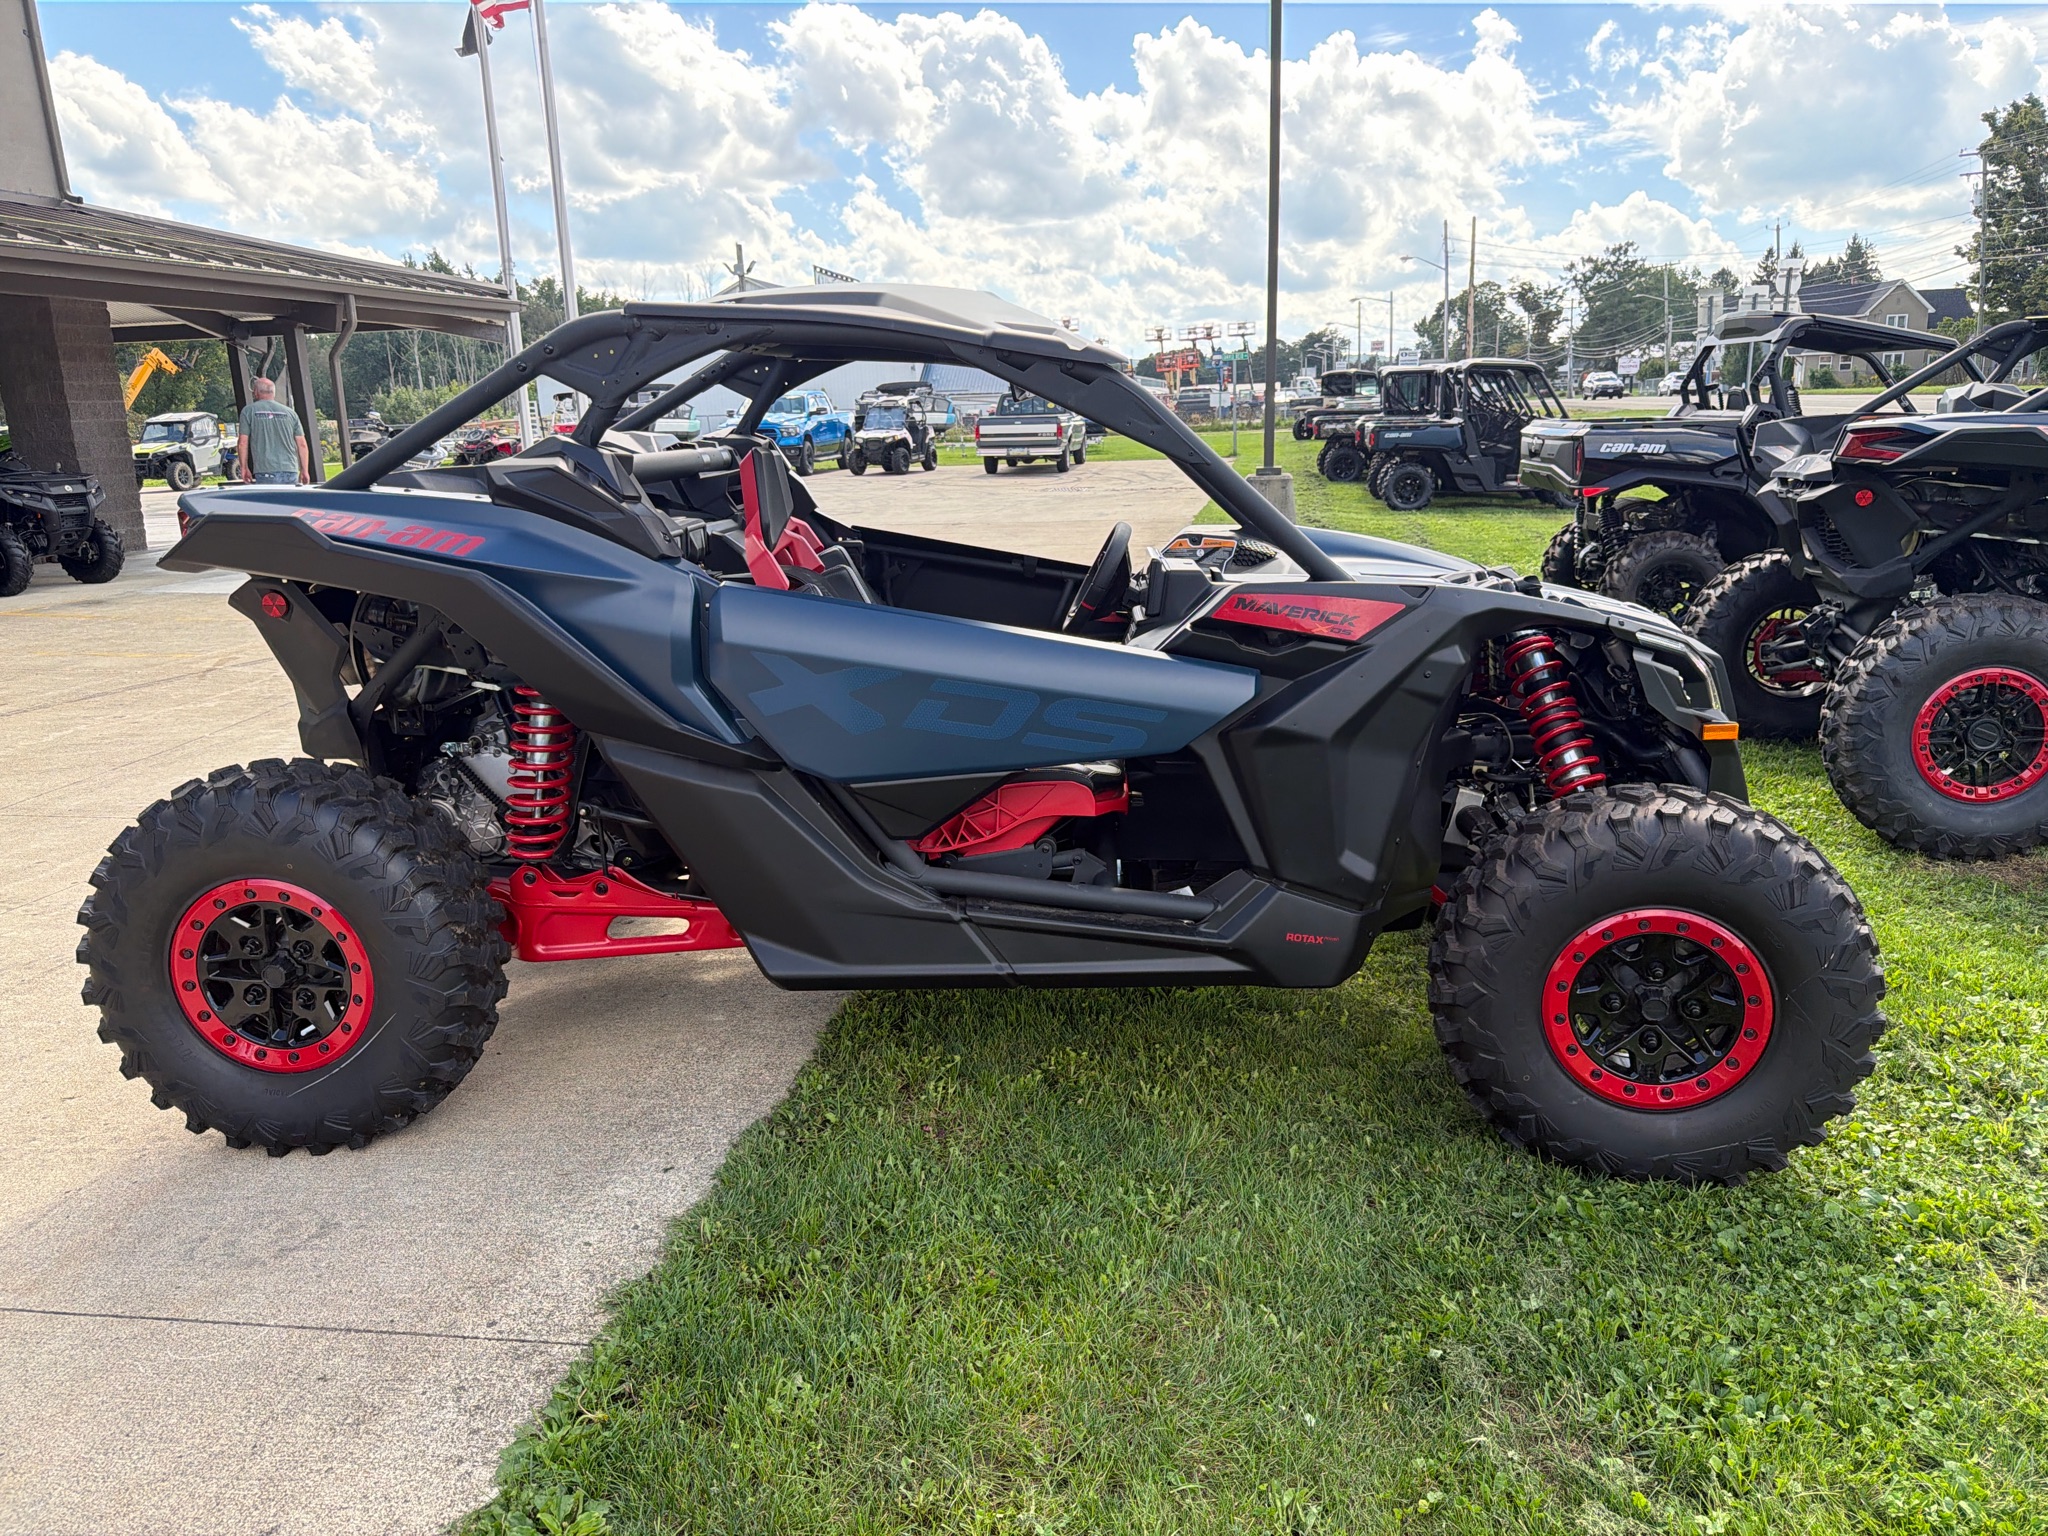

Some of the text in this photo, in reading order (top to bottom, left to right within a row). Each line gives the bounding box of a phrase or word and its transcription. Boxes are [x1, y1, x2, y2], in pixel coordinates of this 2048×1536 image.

[1599, 442, 1667, 455] can-am
[1233, 596, 1361, 628] MAVERICK
[1285, 932, 1324, 945] ROTAX
